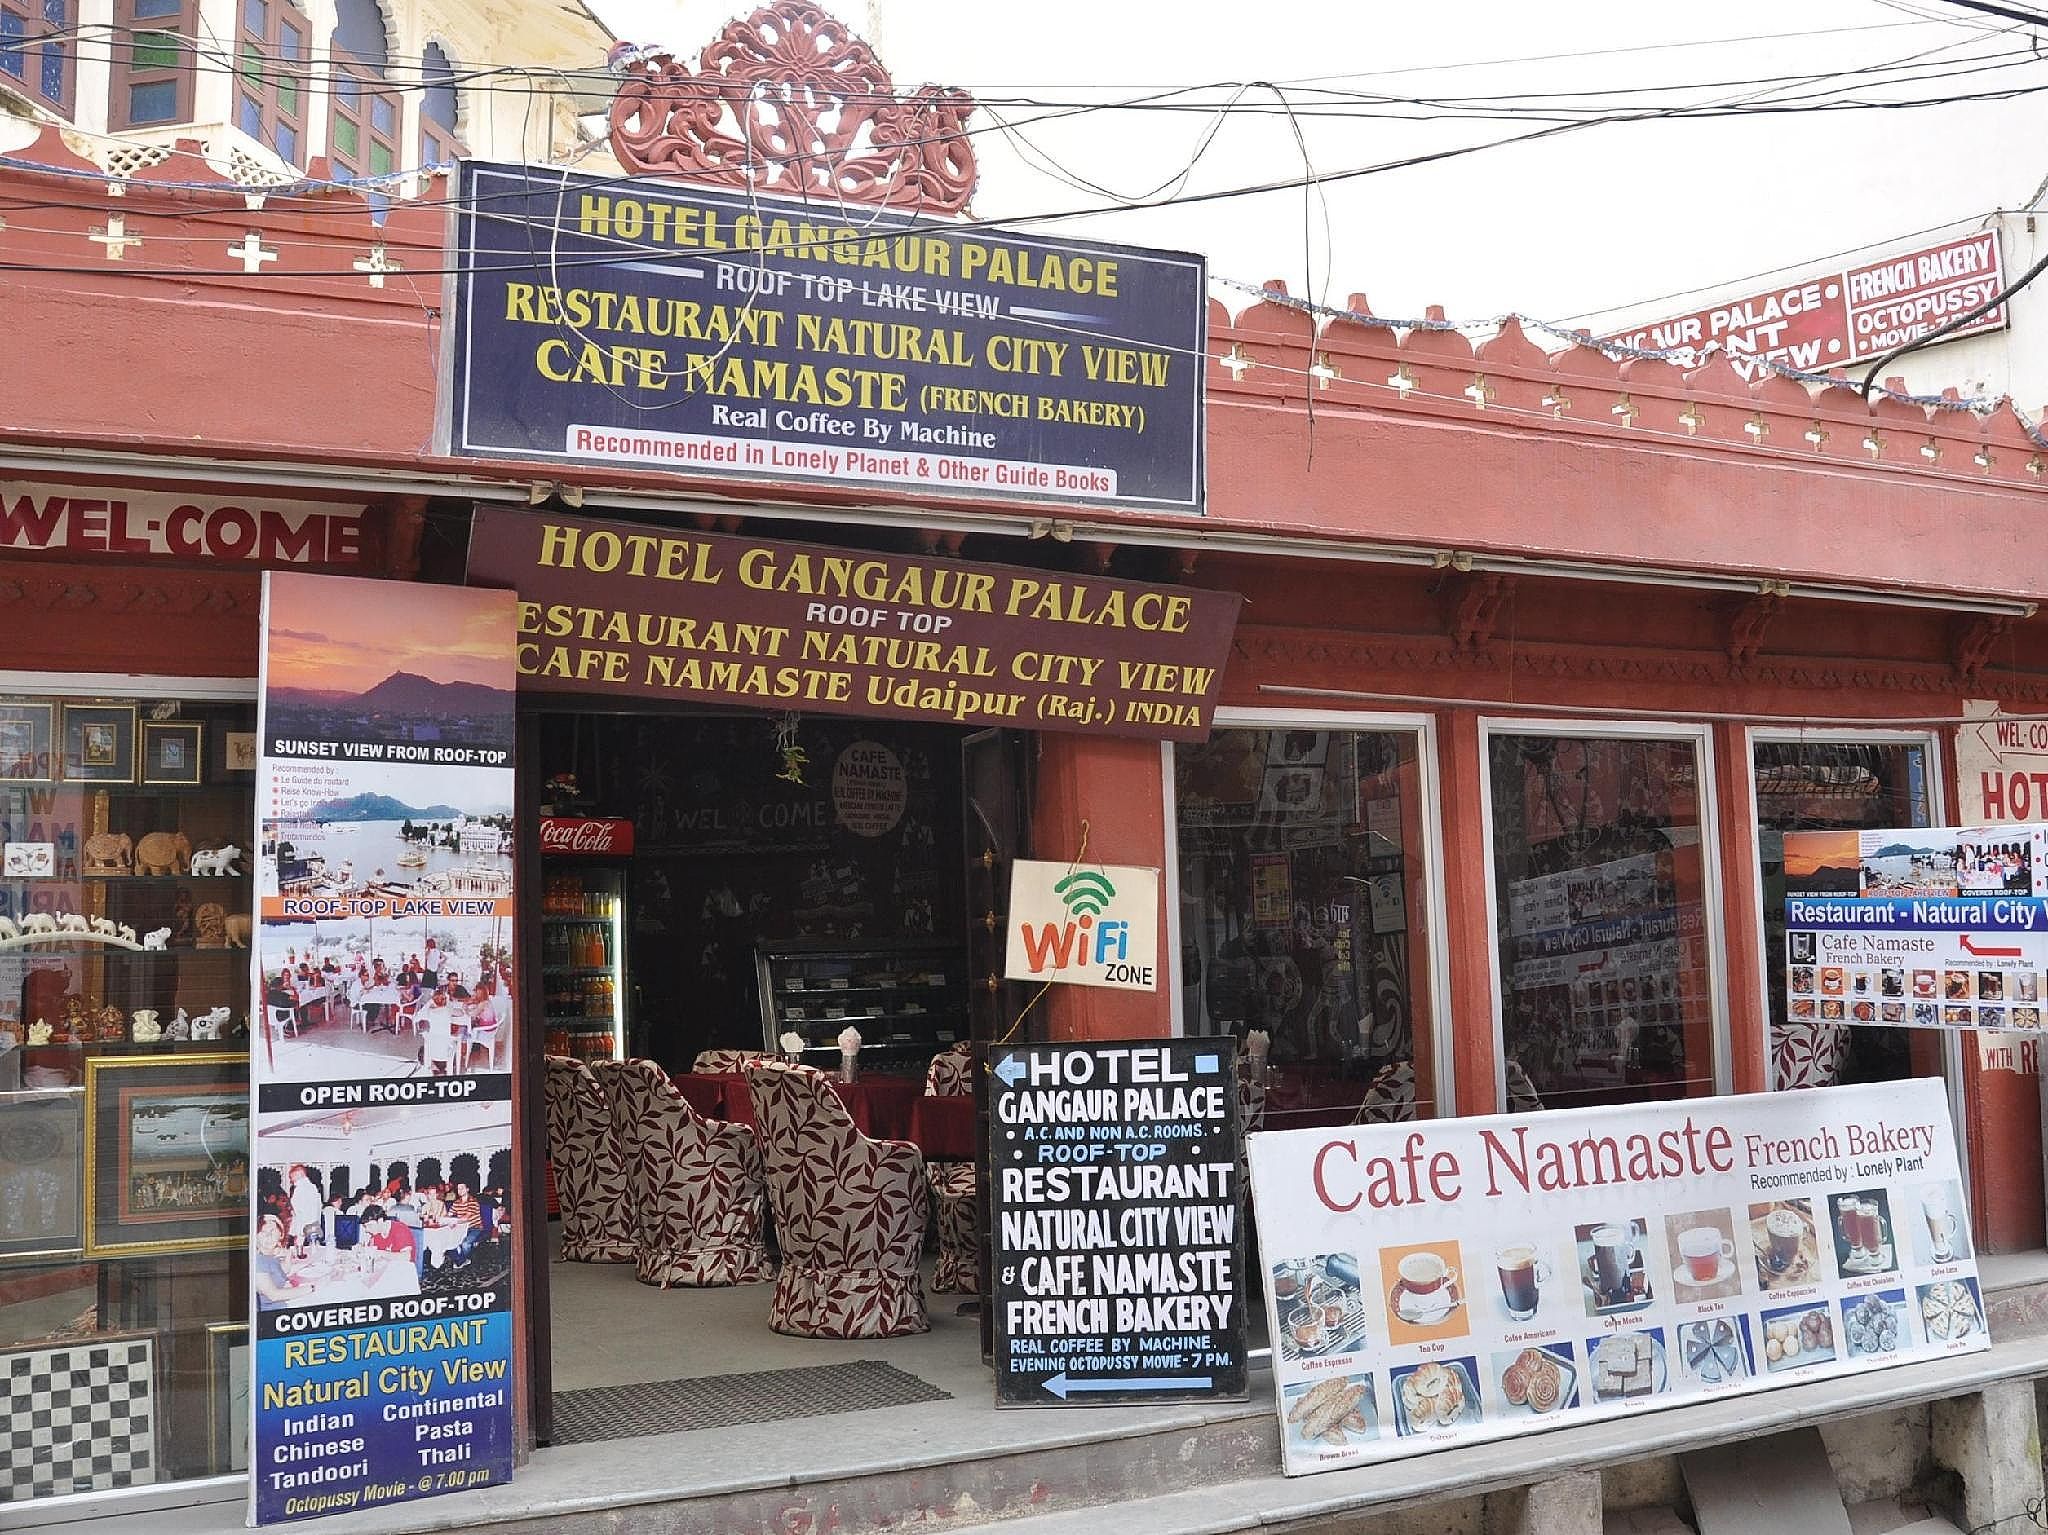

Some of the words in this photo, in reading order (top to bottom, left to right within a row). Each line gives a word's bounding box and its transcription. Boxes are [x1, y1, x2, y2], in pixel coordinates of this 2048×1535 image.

[579, 195, 727, 250] HOTEL
[735, 214, 950, 278] GANGAUR
[961, 242, 1119, 297] PALACE
[1850, 260, 1917, 303] FRENCH
[1917, 239, 1993, 286] BAKERY
[716, 264, 793, 297] ROOF
[804, 274, 852, 303] TOP
[862, 280, 928, 312] LAKE
[935, 289, 1000, 321] VIEW
[1709, 284, 1822, 336] PALACE
[1857, 280, 1996, 334] OCTOPUSSY
[505, 282, 784, 348] RESTAURANT
[796, 314, 974, 368] NATURAL
[986, 336, 1069, 377] CITY
[1081, 345, 1171, 387] VIEW
[535, 339, 669, 391] CAFE
[684, 353, 908, 413] NAMASTE
[920, 384, 1030, 418] (FRENCH
[1036, 397, 1147, 434] BAKERY)
[712, 404, 767, 429] Real
[775, 410, 856, 436] Coffee
[863, 418, 893, 443] By
[900, 421, 997, 449] Machine
[576, 429, 738, 462] Recommended
[746, 443, 764, 465] in
[771, 446, 839, 474] Lonely
[846, 452, 909, 476] Planet
[917, 457, 930, 476] &
[938, 459, 990, 482] Other
[995, 467, 1049, 488] Guide
[1055, 470, 1109, 492] Books
[0, 493, 364, 563] WEL-COME
[537, 525, 724, 584] HOTEL
[738, 548, 995, 614] GANGAUR
[1004, 578, 1192, 633] PALACE
[806, 602, 888, 629] ROOF
[897, 611, 953, 634] TOP
[516, 600, 790, 658] ESTAURANT
[800, 630, 999, 677] NATURAL
[1011, 651, 1105, 687] CITY
[1118, 660, 1217, 696] VIEW
[516, 643, 631, 683] CAFE
[644, 654, 852, 702] NAMASTE
[866, 677, 1026, 721] Udaipur
[1036, 694, 1117, 726] (Raj.)
[1124, 701, 1201, 727] INDIA
[274, 739, 339, 757] SUNSET
[343, 743, 384, 759] VIEW
[387, 745, 430, 761] FROM
[434, 747, 507, 764] ROOF-TOP
[839, 763, 902, 781] NAMASTE
[851, 749, 888, 766] CAFE
[540, 819, 615, 852] Coca-Cola
[284, 899, 386, 915] ROOF-TOP
[391, 900, 442, 915] LAKE
[446, 900, 494, 914] VIEW
[1791, 900, 1896, 924] Restaurant
[1912, 900, 1987, 924] Natural
[1993, 899, 2037, 930] City
[1822, 934, 1858, 951] Cafe
[1862, 934, 1935, 952] Namaste
[1826, 951, 1863, 965] French
[1866, 952, 1905, 968] Bakery
[1105, 963, 1153, 986] ZONE
[1030, 1047, 1189, 1087] HOTEL
[1986, 1047, 2014, 1069] WITH
[299, 1085, 362, 1105] OPEN
[368, 1080, 477, 1102] ROOF-TOP
[998, 1088, 1118, 1124] GANGAUR
[1123, 1086, 1225, 1122] PALACE
[1038, 1144, 1168, 1163] ROOF-TOP
[1054, 1126, 1085, 1141] AND
[1089, 1125, 1122, 1140] NON
[1002, 1162, 1235, 1204] RESTAURANT
[1312, 1132, 1463, 1214] Cafe
[1478, 1116, 1735, 1197] Namaste
[1744, 1127, 1841, 1168] French
[1845, 1121, 1935, 1157] Bakery
[1750, 1167, 1833, 1190] Recommended
[1855, 1159, 1893, 1178] Lonely
[1895, 1157, 1924, 1172] Plant
[1000, 1208, 1118, 1251] NATURAL
[1119, 1206, 1170, 1247] CITY
[1173, 1204, 1235, 1245] VIEW
[1001, 1266, 1016, 1285] &
[1020, 1255, 1087, 1296] CAFE
[1092, 1250, 1233, 1295] NAMASTE
[275, 1304, 383, 1332] COVERED
[389, 1292, 497, 1319] ROOF-TOP
[1007, 1298, 1109, 1335] FRENCH
[1115, 1294, 1233, 1334] BAKERY
[284, 1319, 488, 1369] RESTAURANT
[1010, 1339, 1046, 1354] REAL
[1050, 1338, 1104, 1353] COFFEE
[1111, 1338, 1131, 1353] BY
[1010, 1357, 1066, 1373] EVENING
[1069, 1355, 1138, 1371] OCTOPUSSY
[1418, 1345, 1431, 1354] Tea
[1431, 1343, 1445, 1354] Cup
[263, 1370, 369, 1410] Natural
[377, 1365, 434, 1397] City
[441, 1358, 507, 1386] View
[284, 1413, 355, 1437] Indian
[383, 1391, 503, 1422] Continental
[273, 1437, 366, 1463] Chinese
[415, 1419, 474, 1442] Pasta
[270, 1458, 369, 1490] Tandoori
[418, 1443, 472, 1467] Thali
[285, 1489, 360, 1516] Octopussy
[363, 1480, 407, 1501] Movie
[418, 1476, 434, 1492] @
[435, 1471, 466, 1490] 7.00
[467, 1468, 490, 1486] pm
